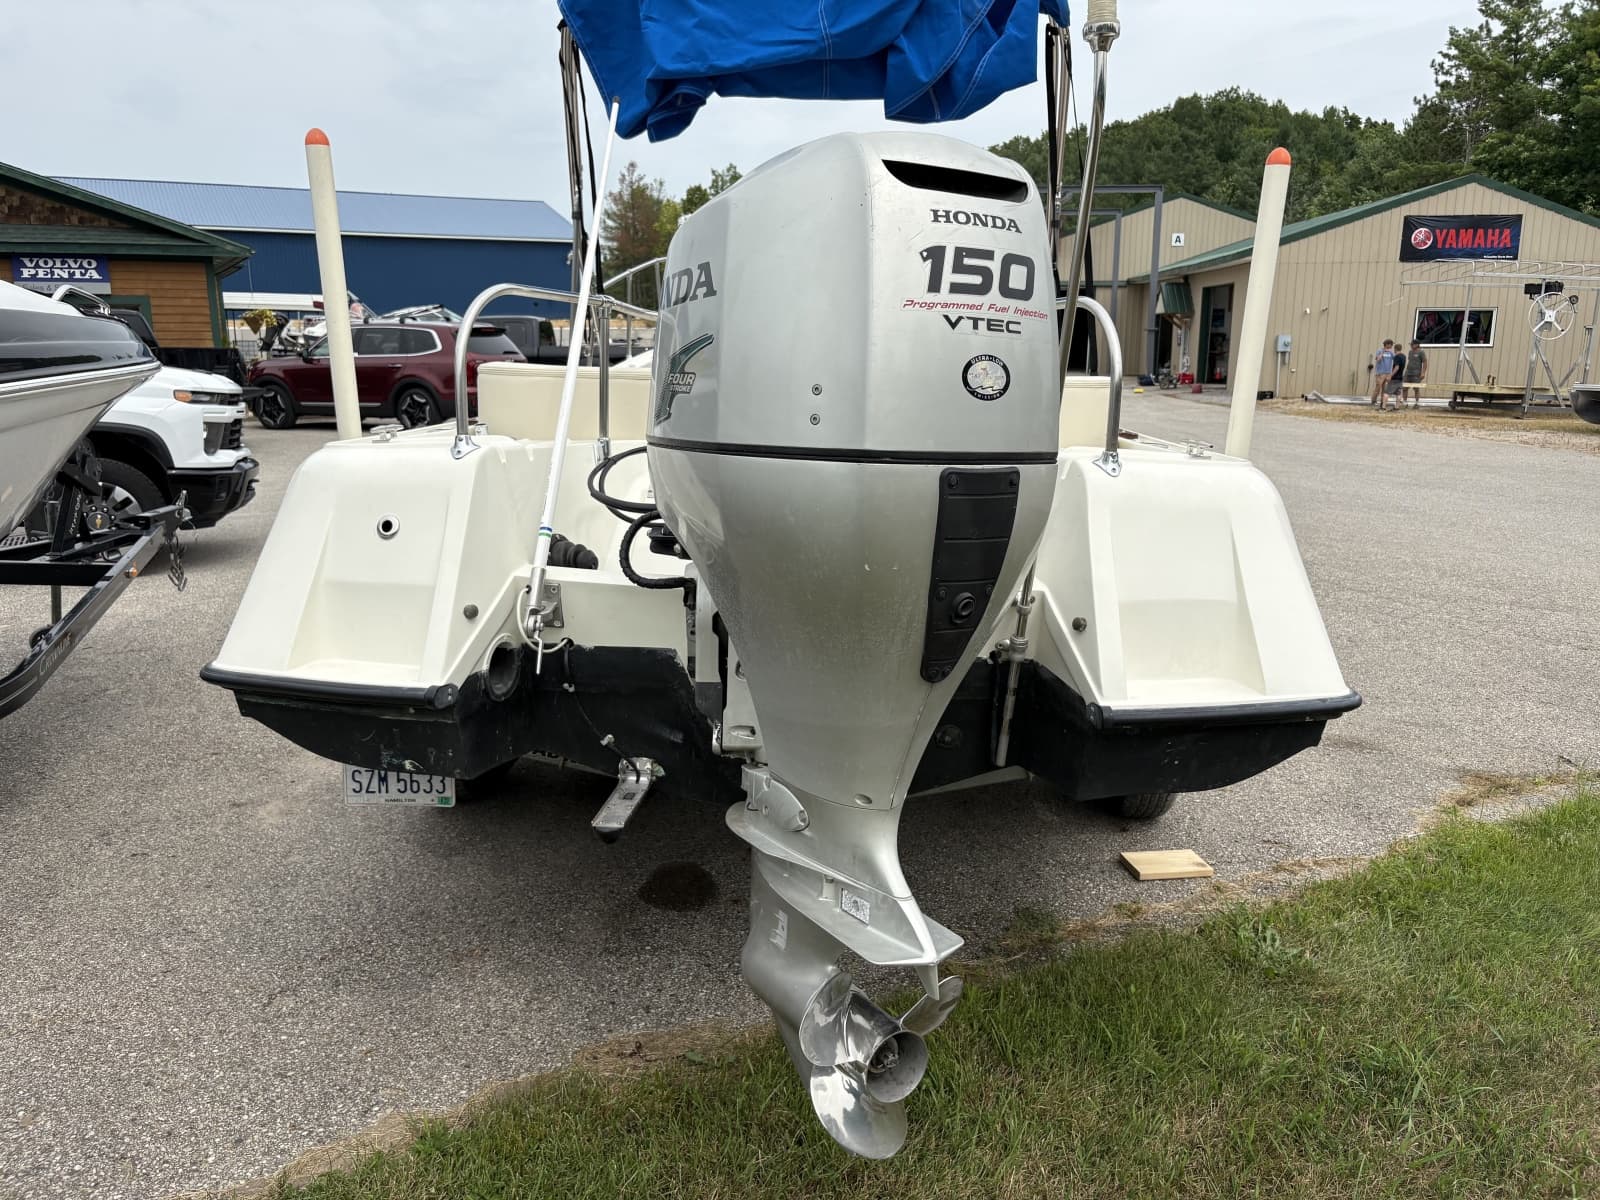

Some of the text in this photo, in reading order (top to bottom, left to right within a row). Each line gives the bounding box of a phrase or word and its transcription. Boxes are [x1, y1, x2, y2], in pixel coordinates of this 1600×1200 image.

[930, 209, 1022, 233] HONDA
[1175, 235, 1182, 244] A
[1435, 228, 1513, 249] YAMAHA
[20, 257, 97, 268] VOLVO
[919, 245, 1036, 301] 150
[20, 268, 102, 279] PENTA
[659, 261, 717, 311] NDA
[902, 299, 1049, 320] Programmed Fuel Injection
[943, 314, 1022, 335] VTEC
[667, 373, 696, 385] FOUR
[669, 384, 692, 393] STROKE
[351, 769, 446, 794] SZM 5633
